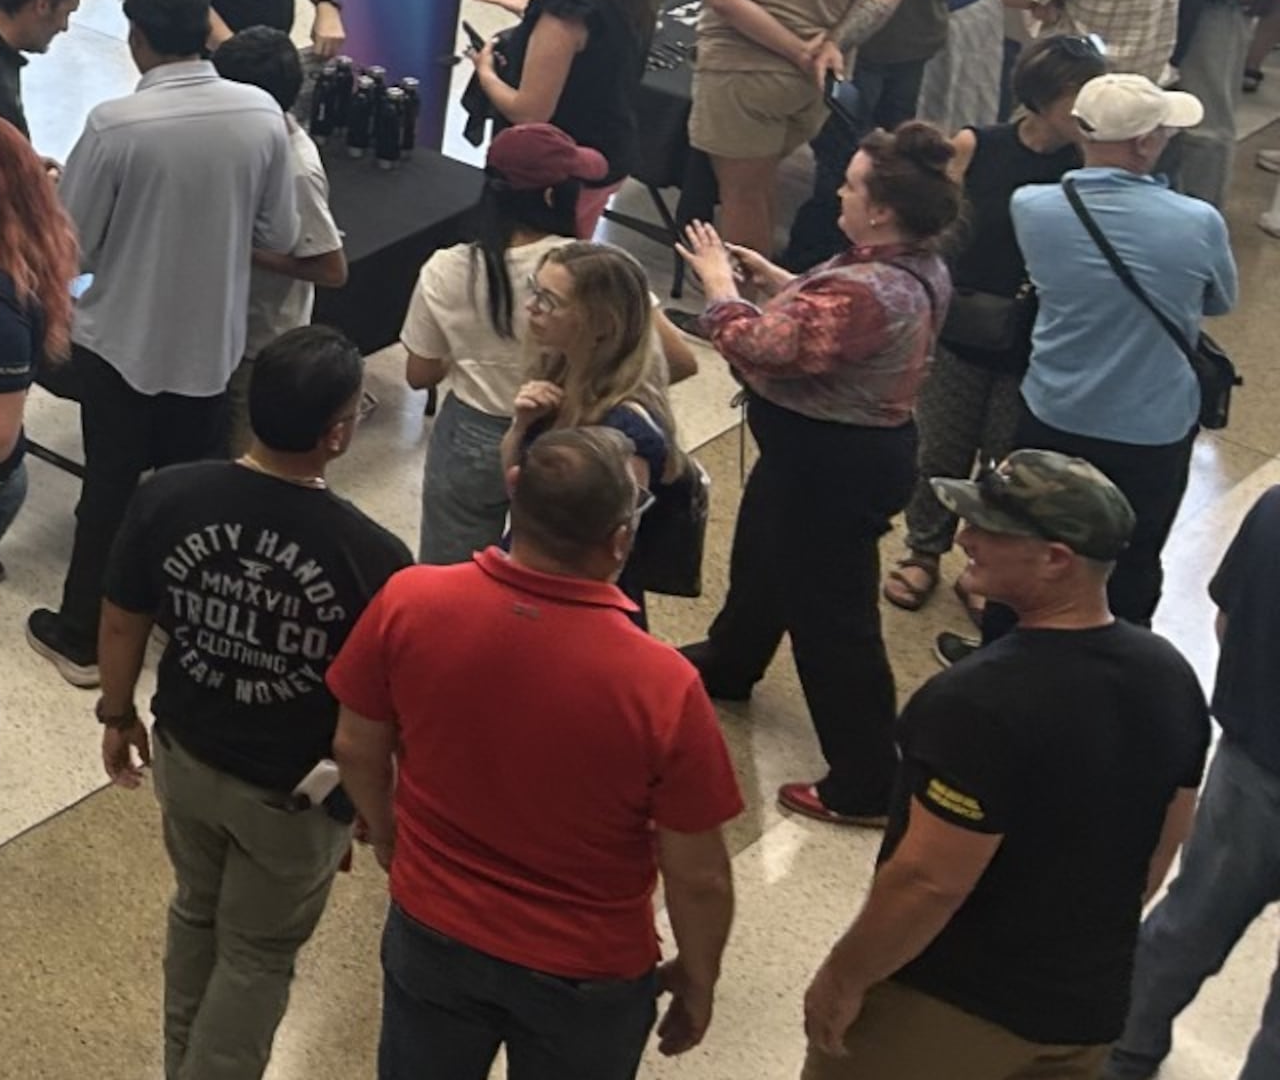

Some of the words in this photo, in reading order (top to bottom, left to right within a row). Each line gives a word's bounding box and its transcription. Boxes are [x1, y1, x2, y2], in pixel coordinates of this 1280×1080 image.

[162, 523, 243, 582] DIRTY
[255, 529, 347, 623] HANDS
[200, 570, 301, 618] MMXVII
[167, 584, 261, 646] TROLL
[174, 625, 226, 688] CEAN
[235, 663, 323, 705] MONEY
[196, 628, 287, 674] CLOTHING
